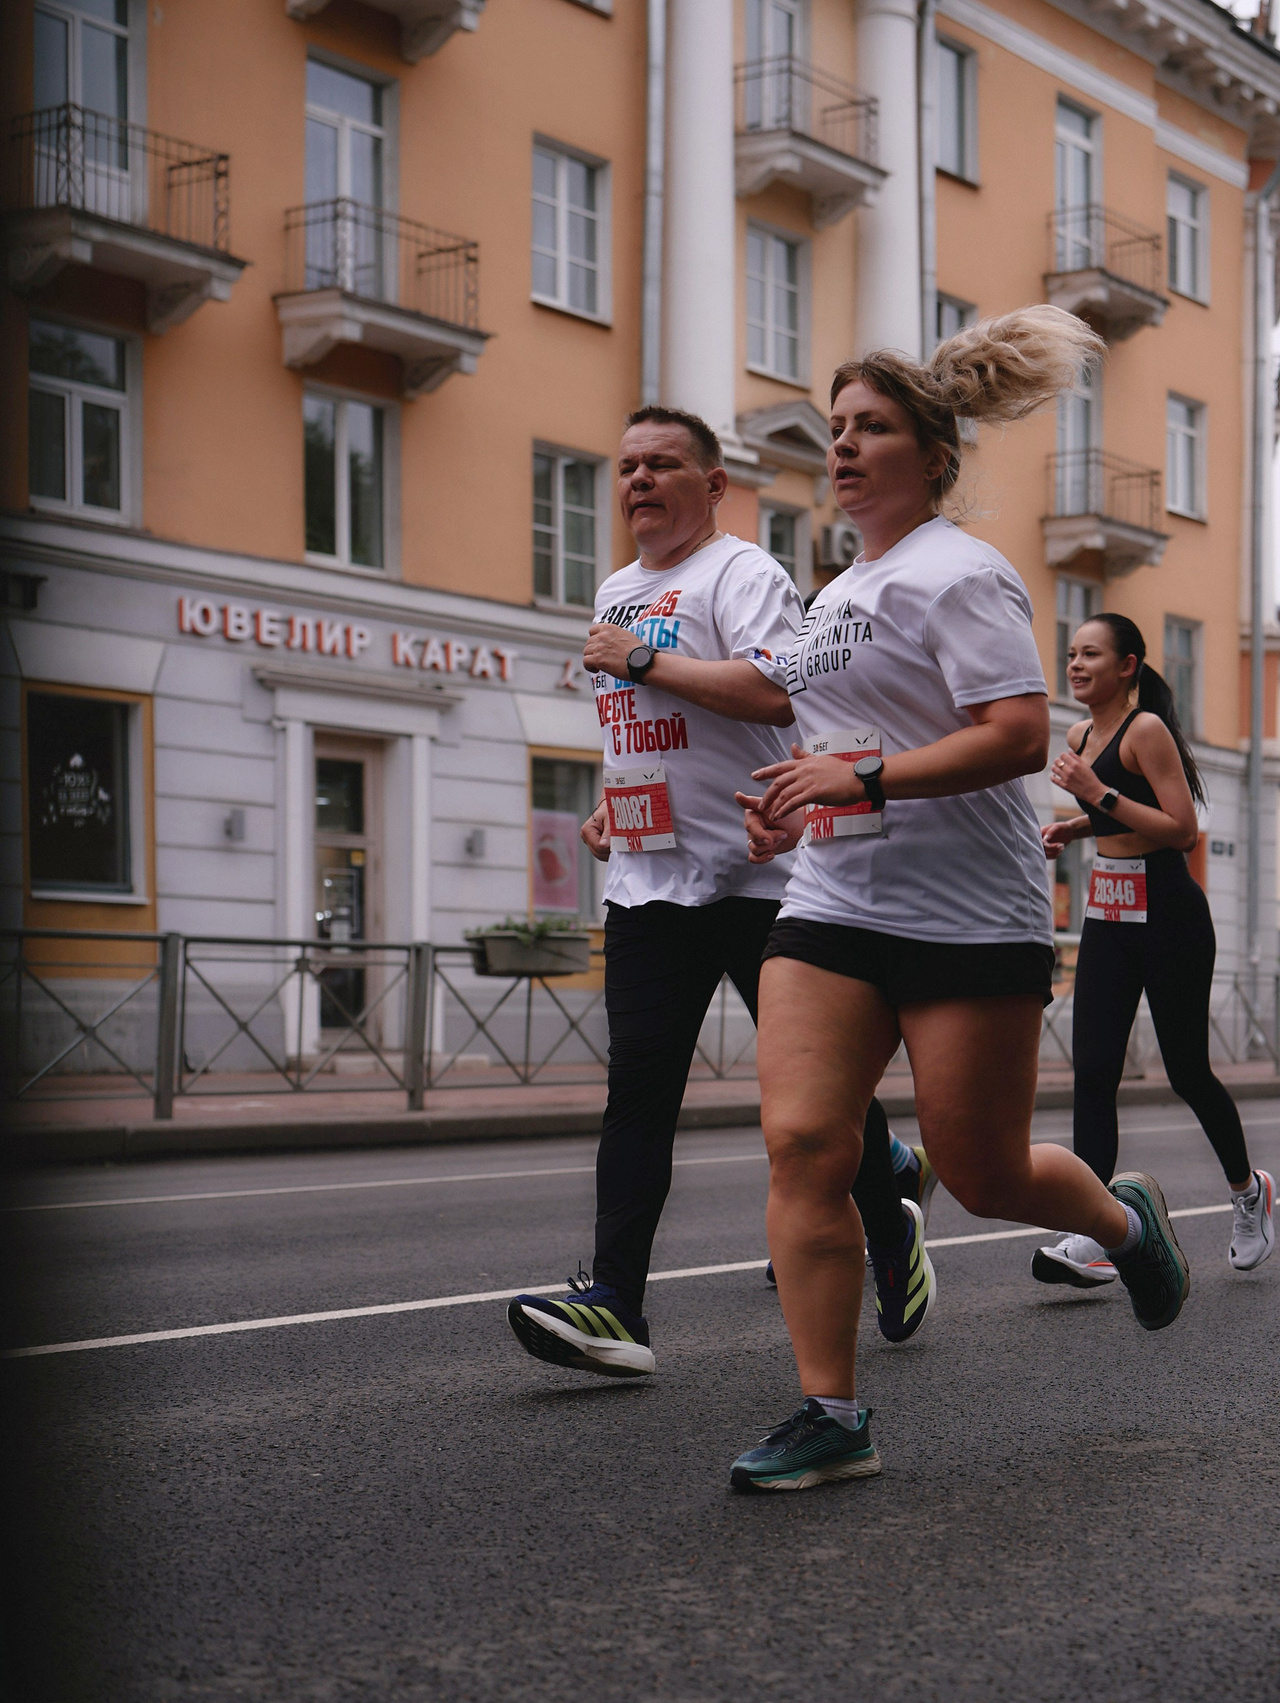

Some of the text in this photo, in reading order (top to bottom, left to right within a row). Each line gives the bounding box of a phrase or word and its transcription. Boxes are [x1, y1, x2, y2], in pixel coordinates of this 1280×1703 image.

[178, 597, 519, 682] ЮВЕЛИР КАРАТ
[808, 621, 873, 652] INFINITA
[806, 648, 852, 678] GROUP
[591, 674, 606, 691] БЕГ
[612, 712, 689, 756] С ТОБОЙ
[610, 794, 654, 830] 20087
[1094, 877, 1136, 906] 20346
